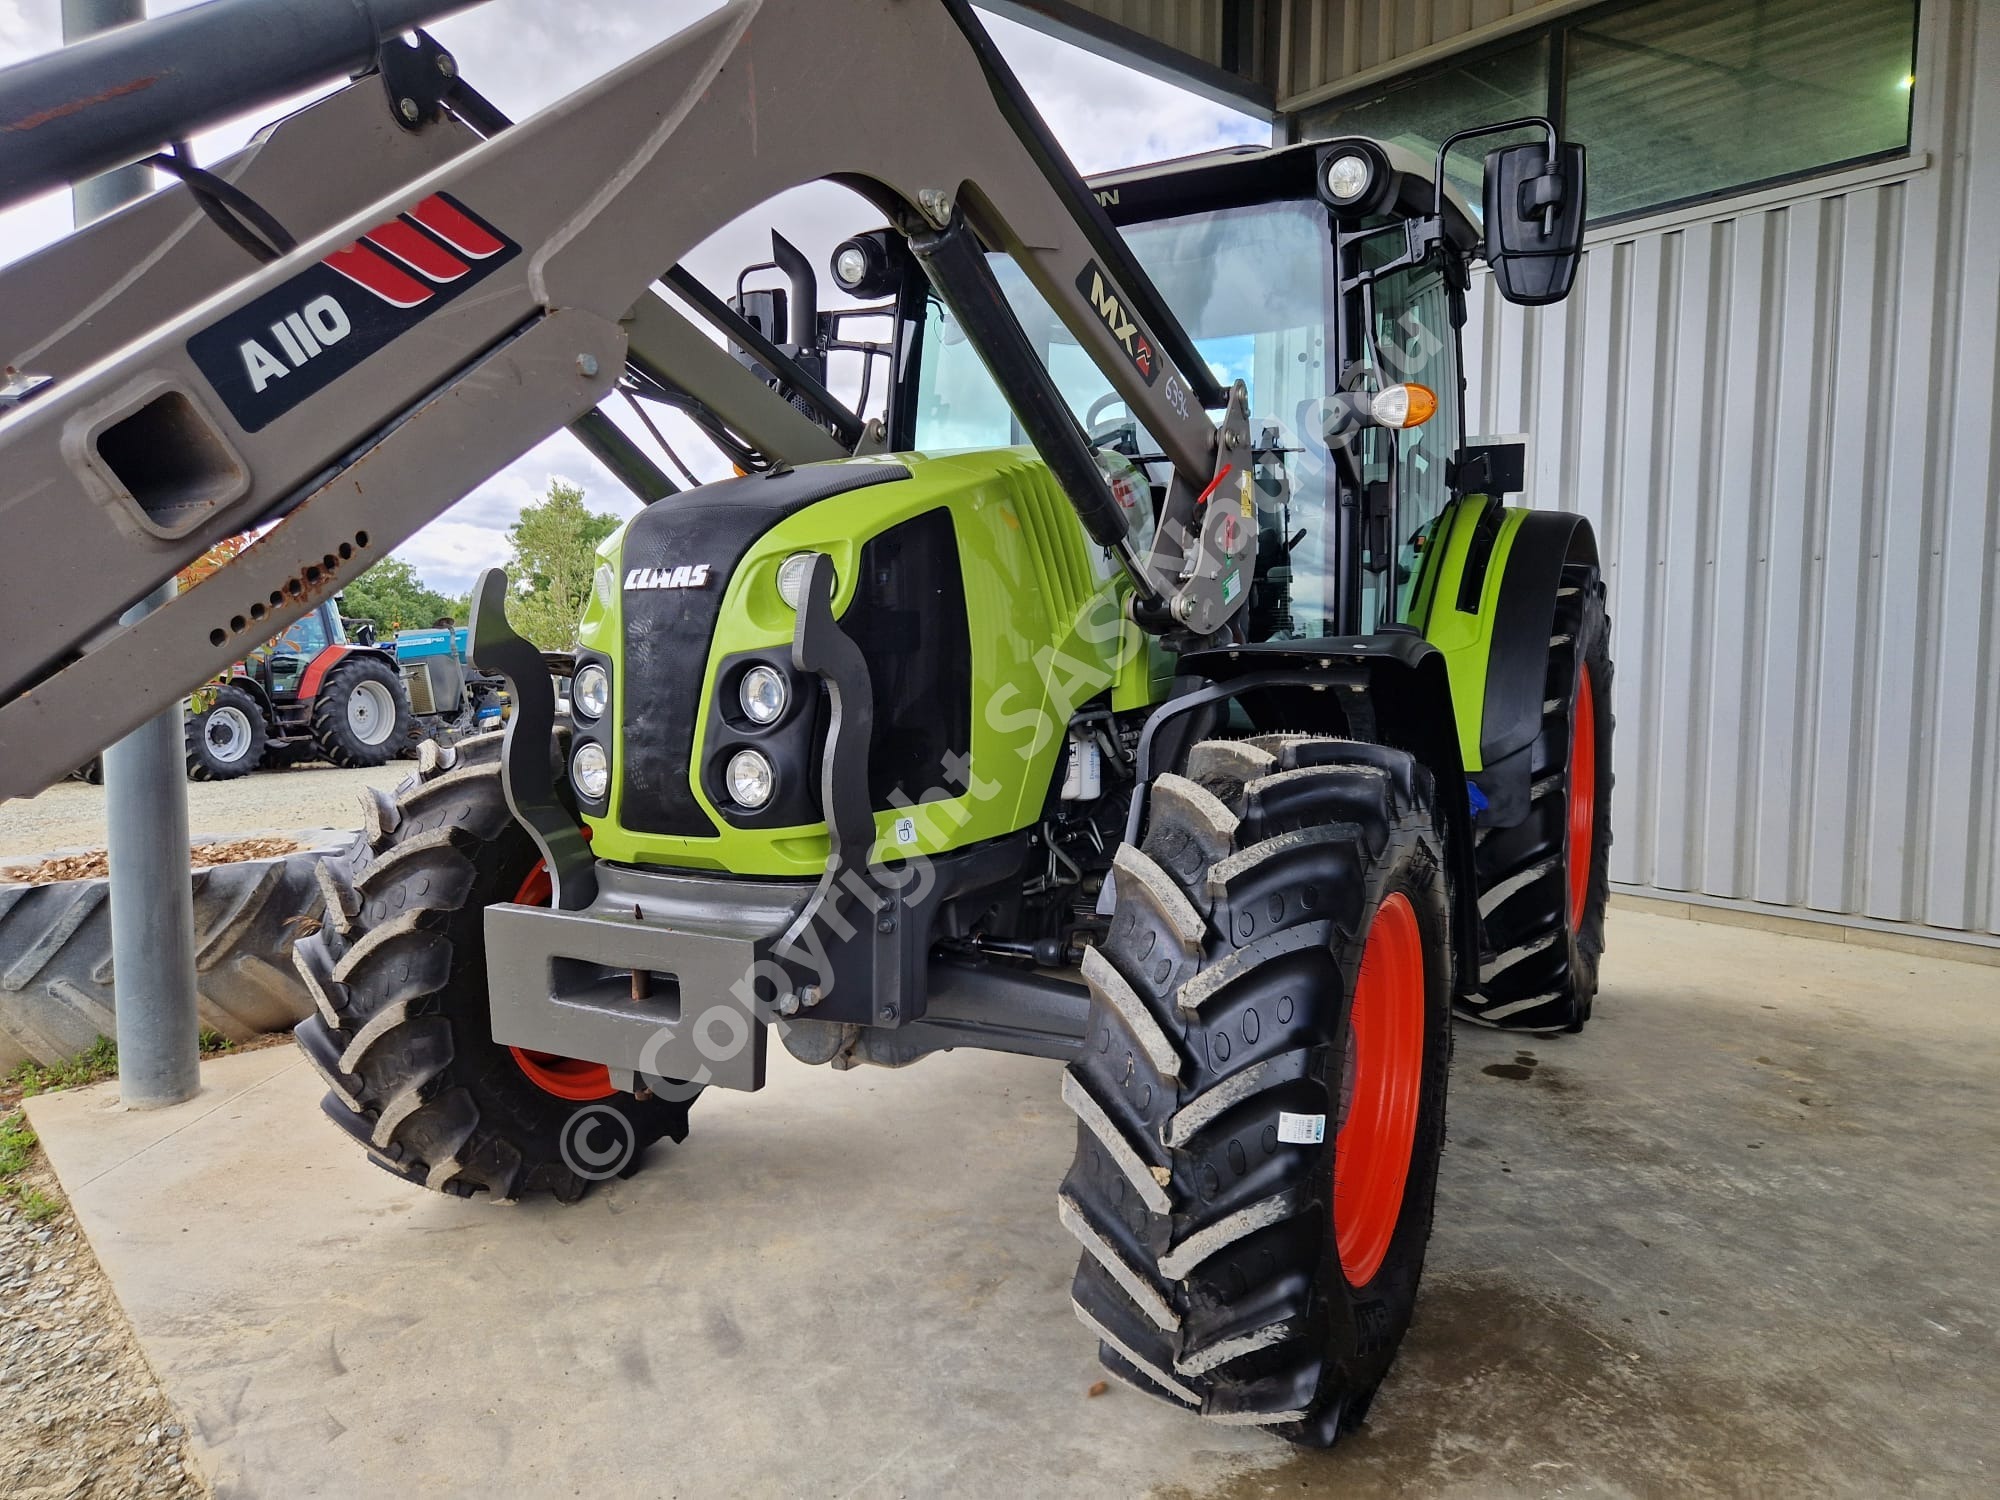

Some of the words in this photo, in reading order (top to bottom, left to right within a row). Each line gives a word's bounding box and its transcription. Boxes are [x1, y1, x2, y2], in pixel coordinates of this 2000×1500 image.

[240, 339, 291, 393] A
[270, 294, 351, 368] 110
[1090, 270, 1138, 357] MX
[623, 564, 711, 590] CLAAS
